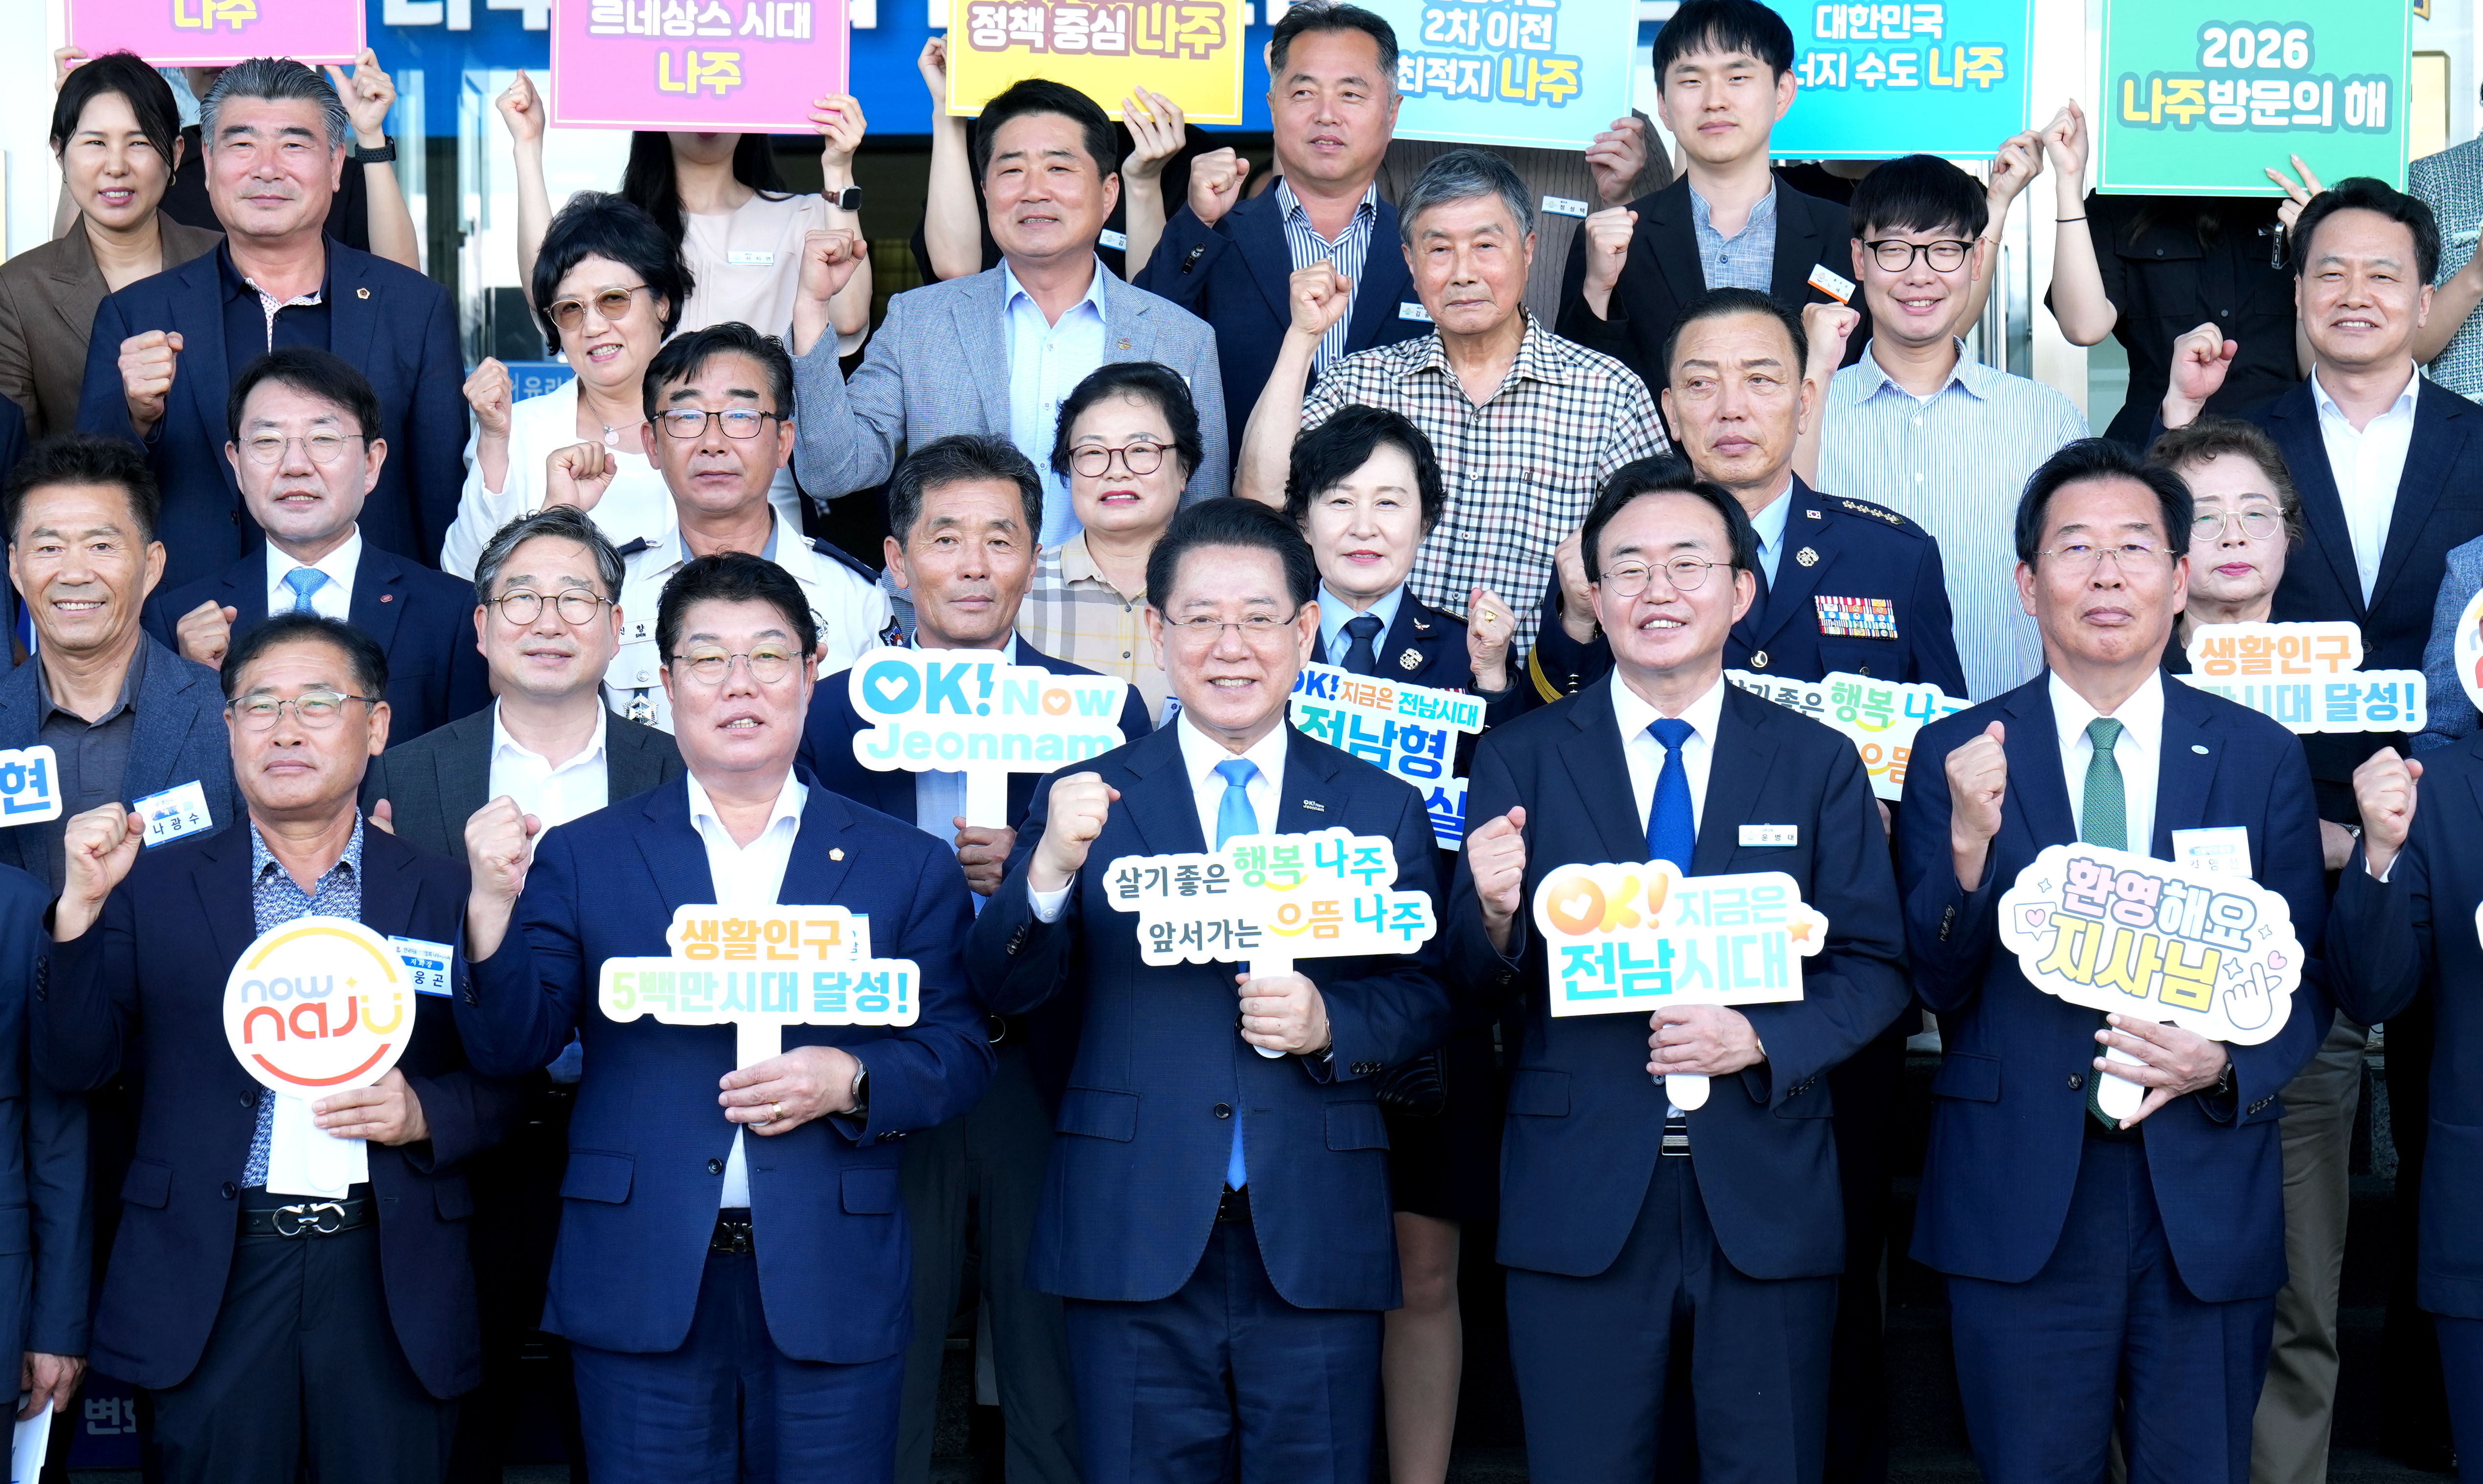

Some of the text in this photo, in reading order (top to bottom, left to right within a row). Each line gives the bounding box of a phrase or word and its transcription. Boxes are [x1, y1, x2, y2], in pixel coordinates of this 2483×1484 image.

[590, 0, 732, 36] 르네상스
[739, 1, 811, 39] 시대
[971, 5, 1045, 48] 정책
[1053, 8, 1126, 50] 중심
[1136, 4, 1221, 54] 나주
[1425, 7, 1552, 51] 2차 이전
[1816, 3, 1944, 39] 대한민국
[1796, 46, 2004, 88] 너지 수도 나주
[2202, 27, 2309, 69] 2026
[659, 50, 741, 94] 나주
[1398, 54, 1578, 103] 최적지 나주
[2123, 78, 2387, 128] 나주방문의 해
[2199, 635, 2351, 676] 생활인구
[862, 660, 995, 717] OK!
[1340, 681, 1394, 711] 지금은
[1398, 692, 1478, 727] 전남시대
[1830, 681, 1895, 728] 행복
[2324, 682, 2416, 722] 달성!
[866, 723, 1114, 762] Jeonnam
[1298, 705, 1447, 779] 전남형
[1115, 838, 1386, 899] 살기 좋은 행복 나주
[1149, 893, 1425, 953] 앞서가는 으뜸 나주
[1546, 872, 1787, 936] OK! 지금은
[2062, 856, 2258, 952] 환영해요
[679, 918, 842, 961] 생활인구
[1560, 931, 1788, 1001] 전남시대
[2036, 912, 2223, 1014] 지사님
[241, 975, 333, 1003] now
[612, 971, 908, 1014] 5백만시대 달성!
